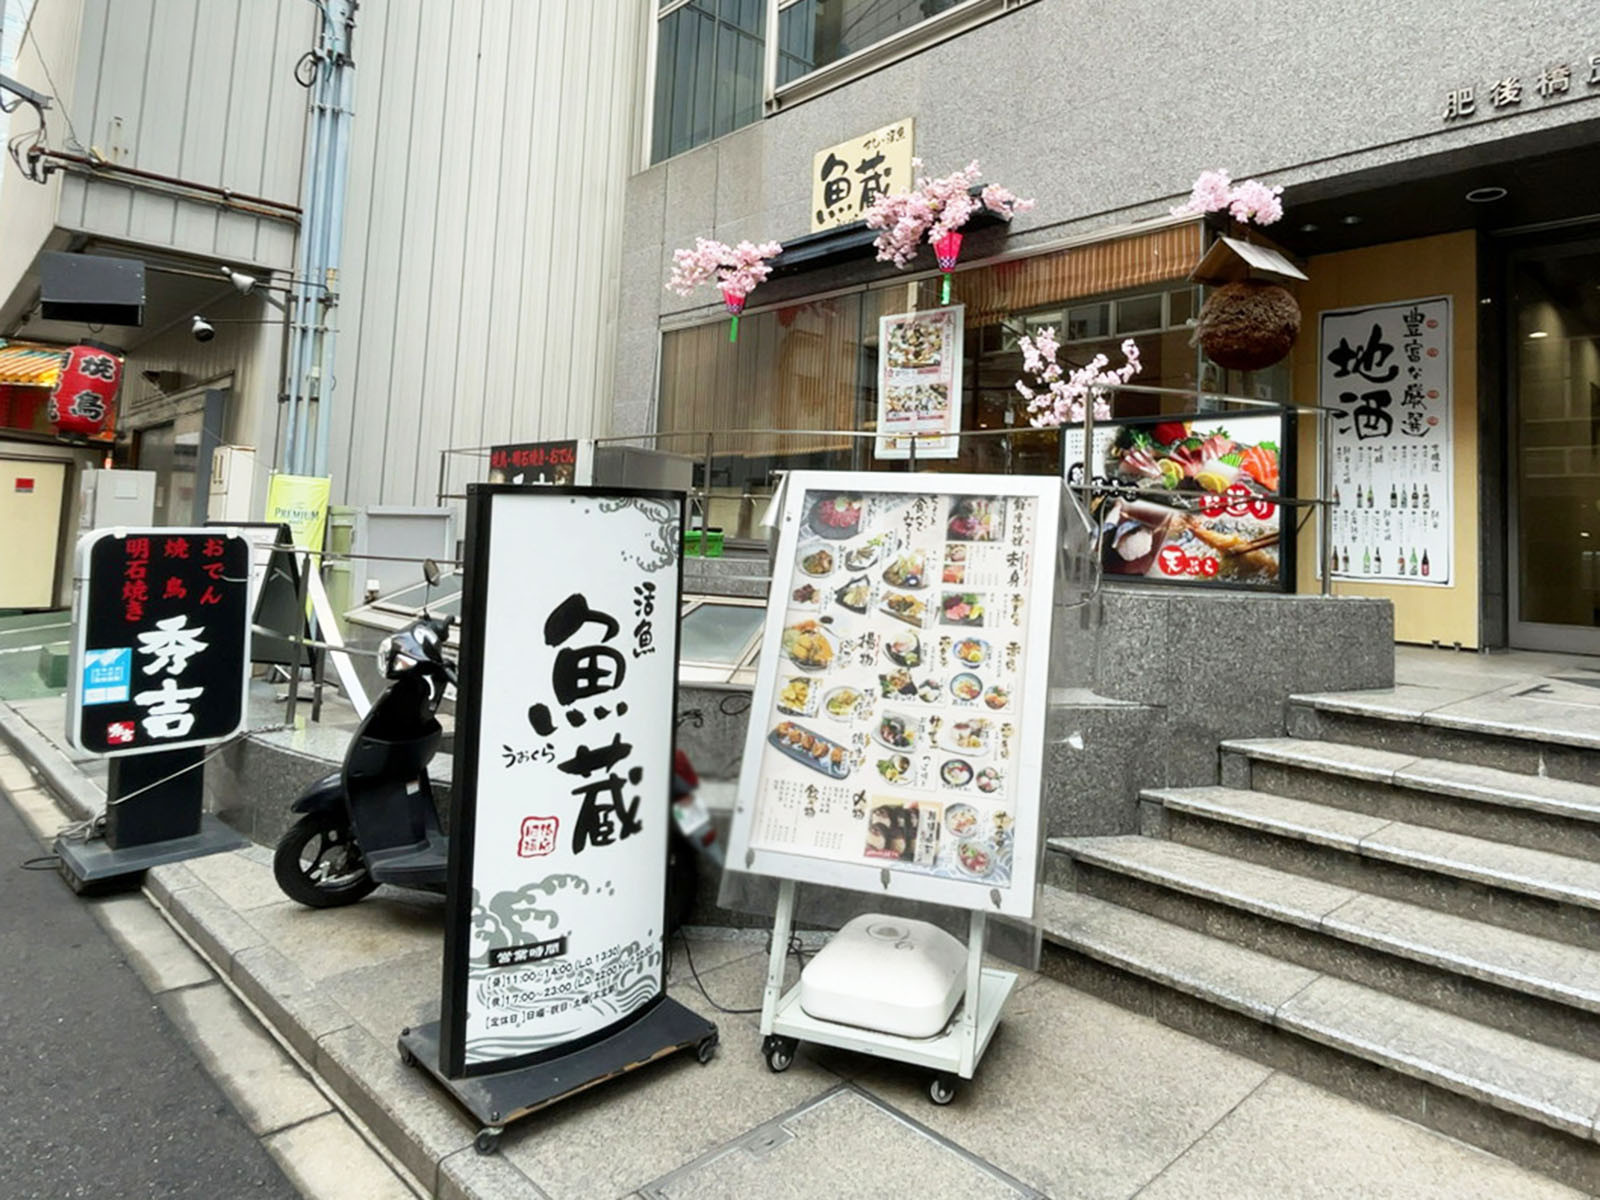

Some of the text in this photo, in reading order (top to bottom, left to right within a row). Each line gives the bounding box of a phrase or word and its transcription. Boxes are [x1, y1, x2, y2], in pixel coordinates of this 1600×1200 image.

[816, 152, 892, 225] 魚蔵
[70, 354, 116, 422] 焼鳥
[1327, 322, 1399, 440] 地酒
[275, 507, 319, 521] PREMIUM
[122, 537, 150, 622] 明石焼き
[162, 537, 190, 599] 焼鳥
[200, 538, 226, 605] おでん
[1007, 550, 1025, 588] 刺身
[1162, 550, 1214, 573] 天ぷら
[632, 581, 657, 659] 活魚
[858, 631, 874, 666] 揚物
[134, 614, 210, 738] 秀吉
[502, 742, 556, 769] うおくら
[527, 592, 644, 856] 魚蔵
[496, 942, 560, 964] 営業時間
